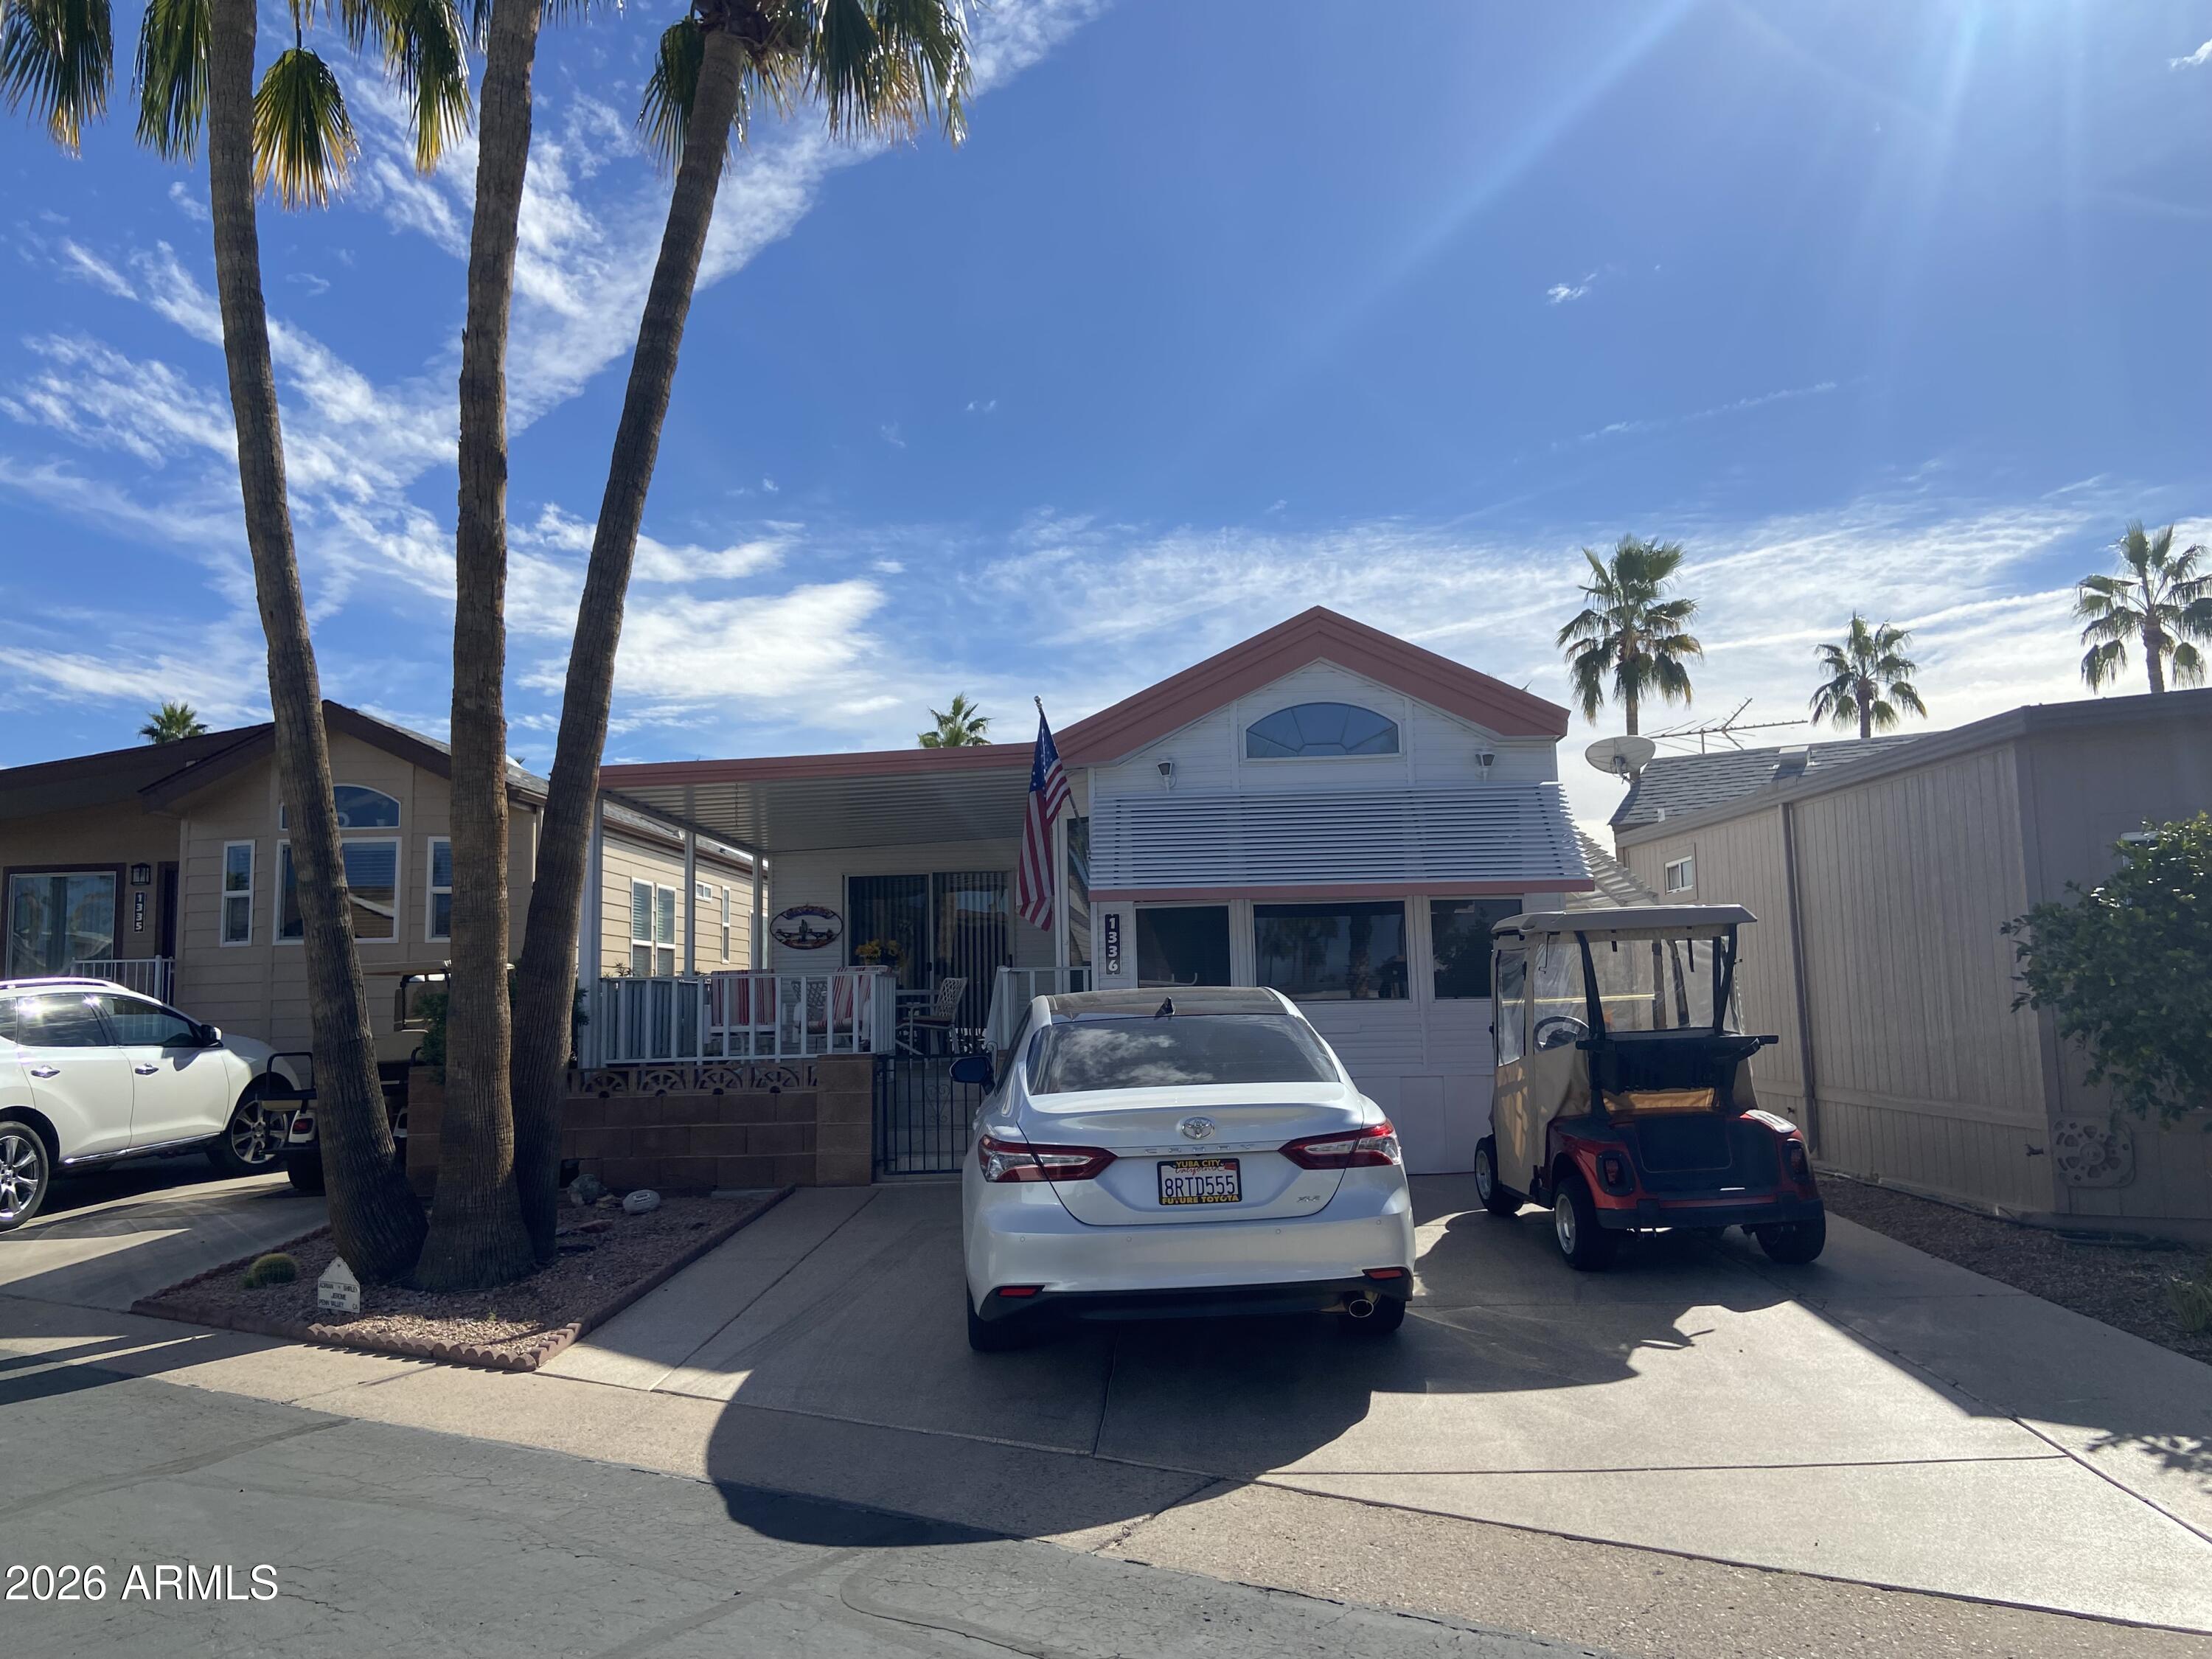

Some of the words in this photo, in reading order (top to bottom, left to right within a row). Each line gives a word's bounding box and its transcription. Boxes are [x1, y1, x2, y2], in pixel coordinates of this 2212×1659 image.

[1108, 917, 1118, 972] 1336
[1202, 1158, 1221, 1166] CITY
[1165, 1175, 1235, 1197] 8RTD555
[1201, 1194, 1239, 1203] TOYOTA
